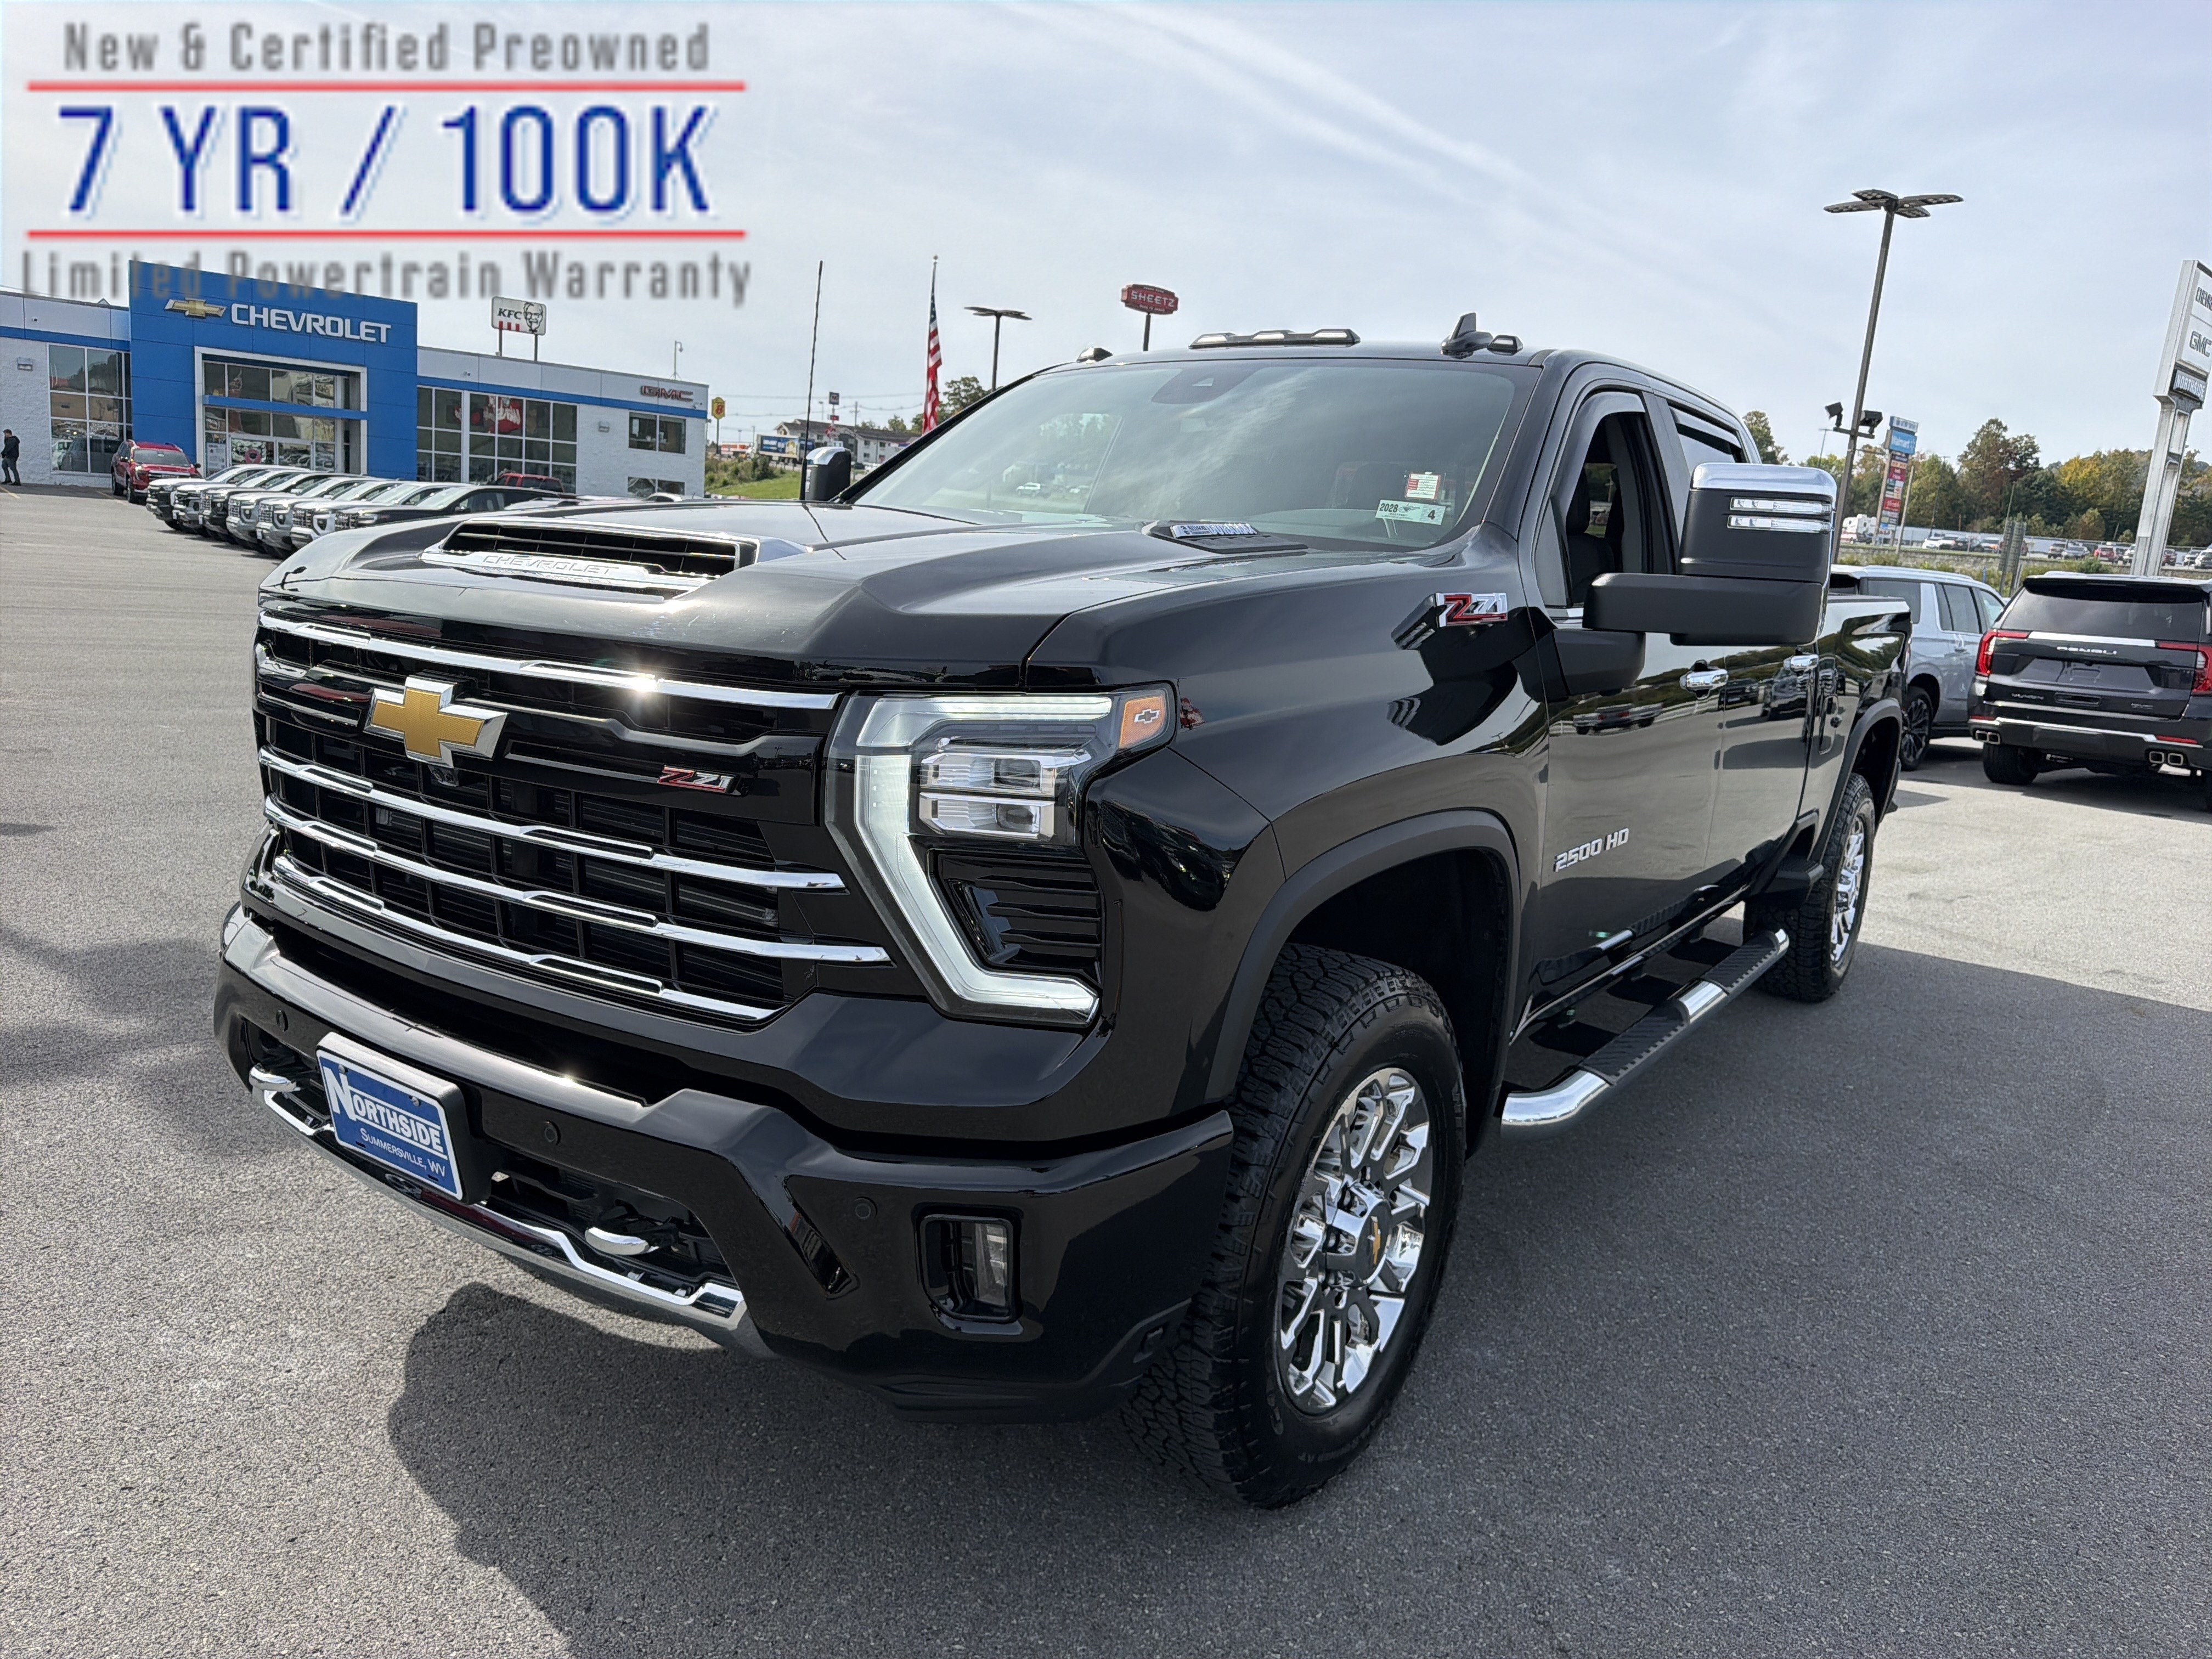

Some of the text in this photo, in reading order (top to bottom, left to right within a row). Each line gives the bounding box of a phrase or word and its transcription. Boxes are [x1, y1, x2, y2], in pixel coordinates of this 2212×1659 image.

[1131, 290, 1175, 308] SHEETZ
[231, 303, 392, 343] CHEVROLET
[497, 308, 522, 320] KFC
[2189, 330, 2212, 357] GMC
[641, 385, 694, 402] GMC
[2175, 374, 2205, 398] NORTHSIDE
[1379, 503, 1436, 520] 2028 4
[482, 555, 619, 575] CHEVROLET
[1436, 592, 1508, 628] Z71
[657, 765, 735, 793] Z71
[1553, 827, 1629, 873] 2500 HD
[323, 1066, 444, 1153] NORTHSIDE
[359, 1127, 446, 1177] SUMMERSVILLE, WV
